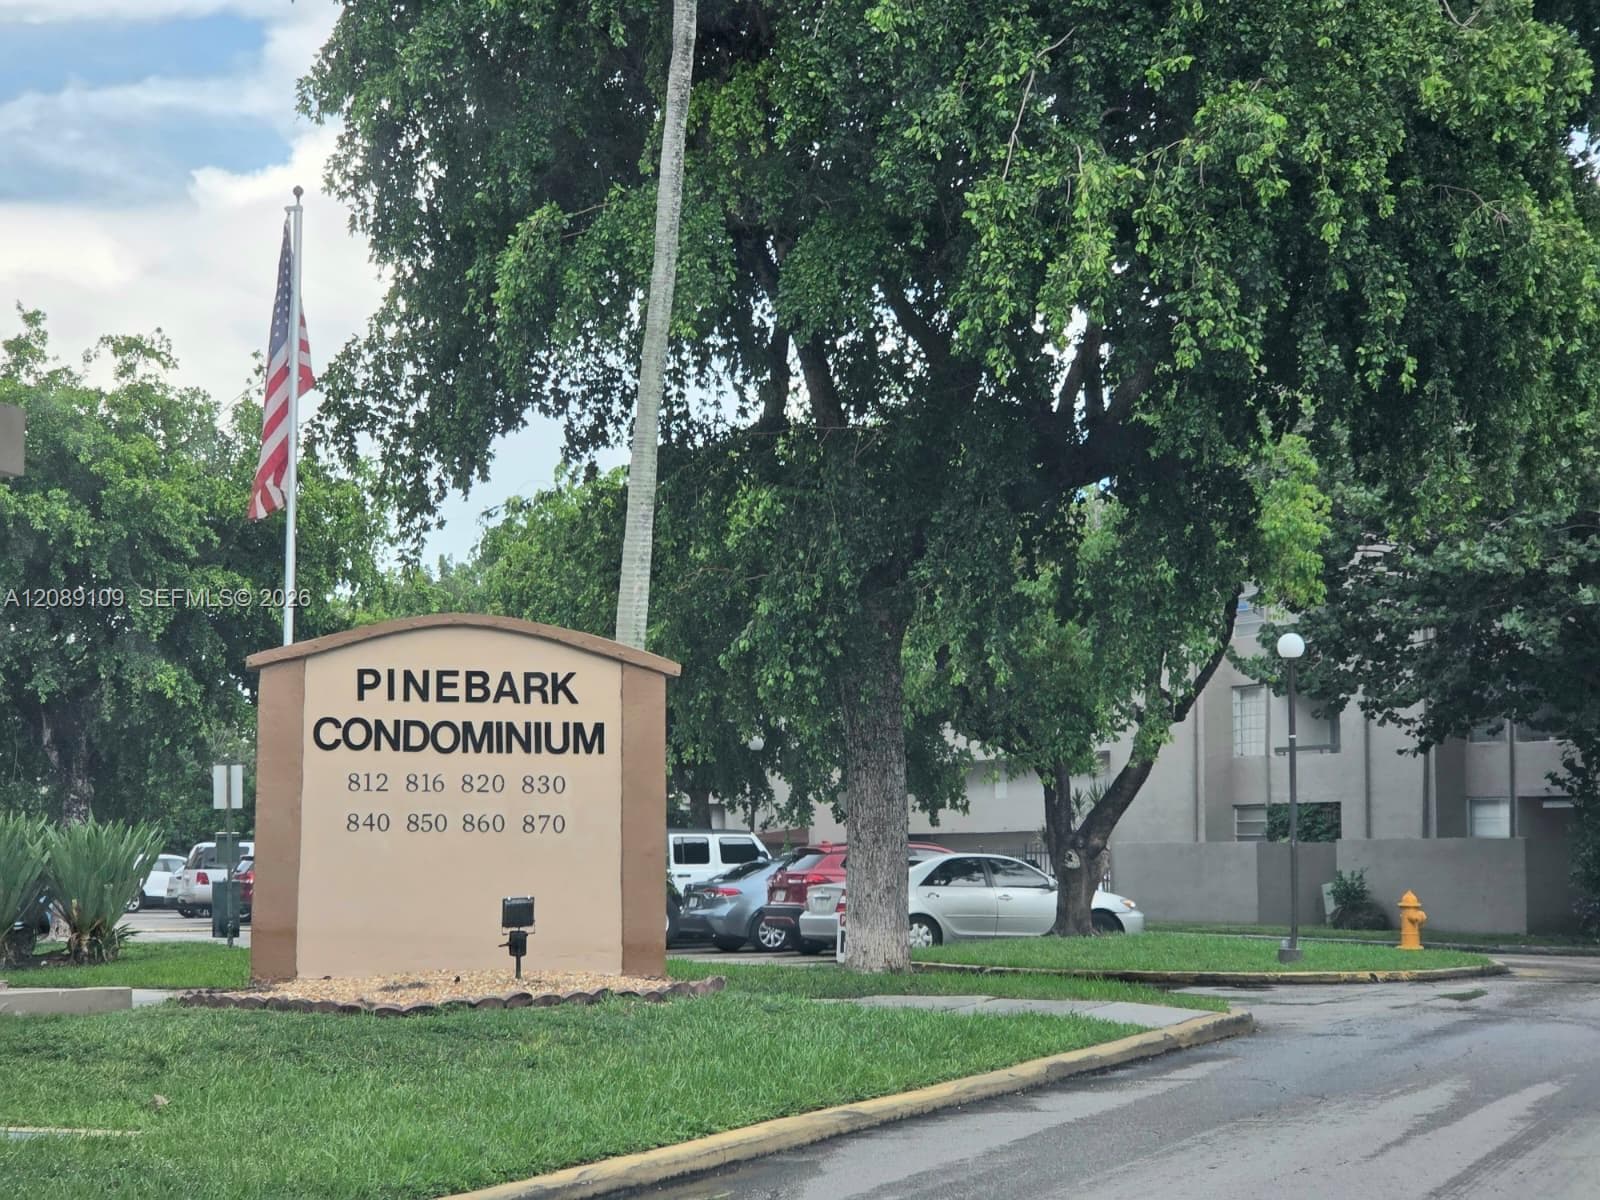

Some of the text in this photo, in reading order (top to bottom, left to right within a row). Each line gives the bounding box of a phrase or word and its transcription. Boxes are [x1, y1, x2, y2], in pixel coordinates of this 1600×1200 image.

[357, 669, 579, 704] PINEBARK
[313, 717, 605, 755] CONDOMINIUM
[347, 773, 566, 795] 812 816 820 830
[347, 813, 566, 834] 840 850 860 870
